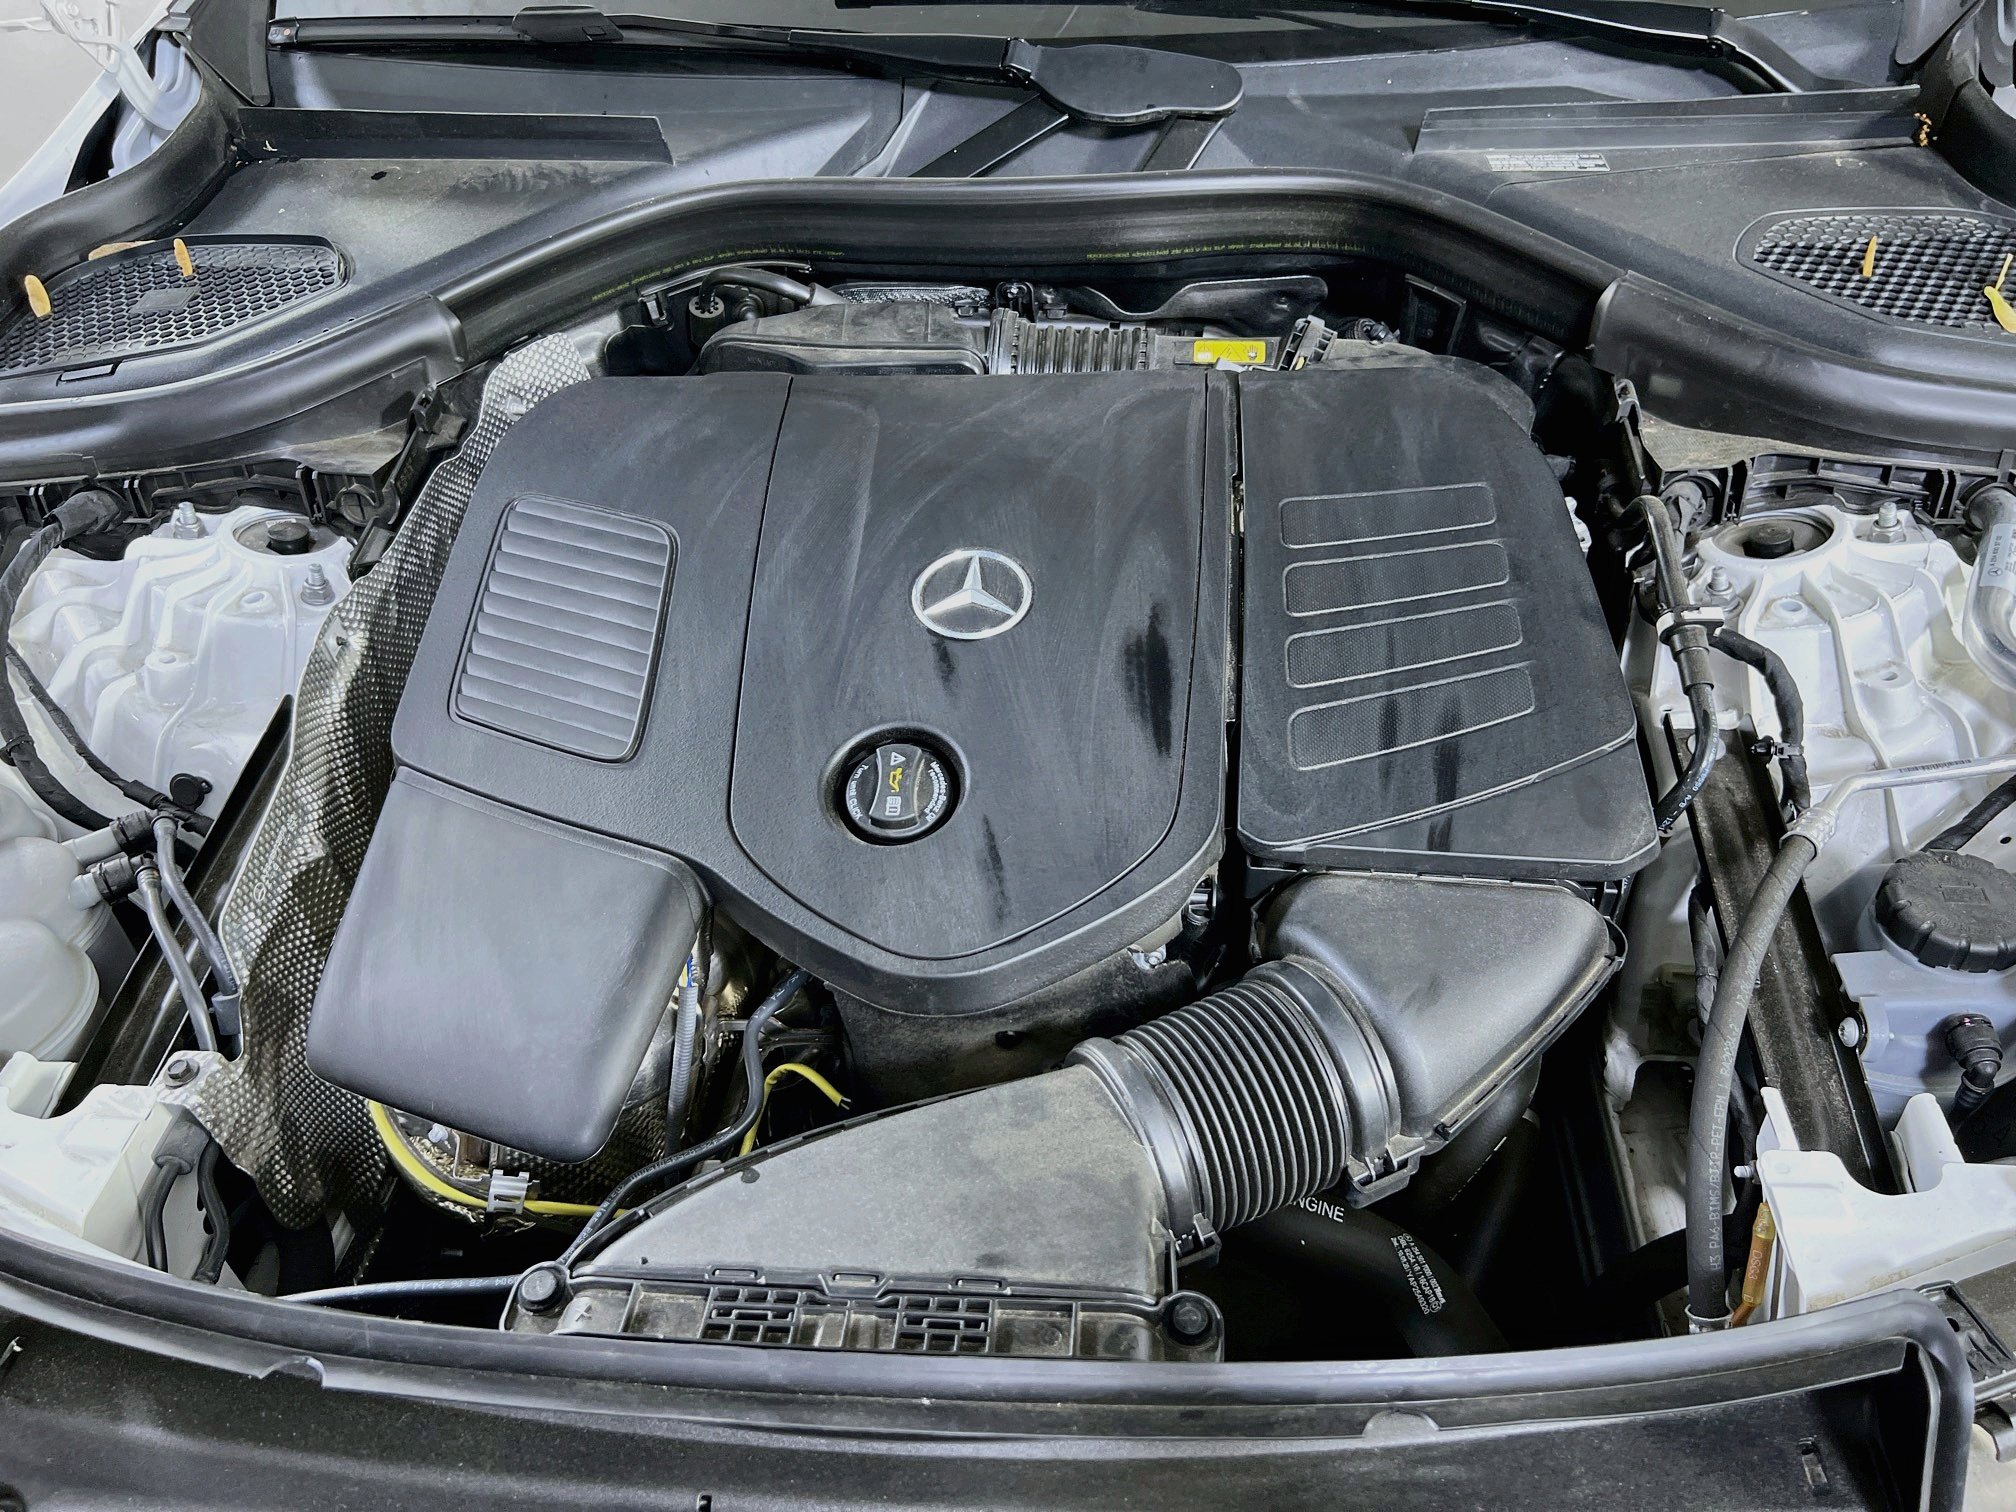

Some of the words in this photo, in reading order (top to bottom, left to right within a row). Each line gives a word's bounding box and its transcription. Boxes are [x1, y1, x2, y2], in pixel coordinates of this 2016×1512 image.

[930, 761, 948, 812] Mercedes-Benz
[848, 797, 864, 821] CLICK
[1292, 1196, 1344, 1222] NGINE
